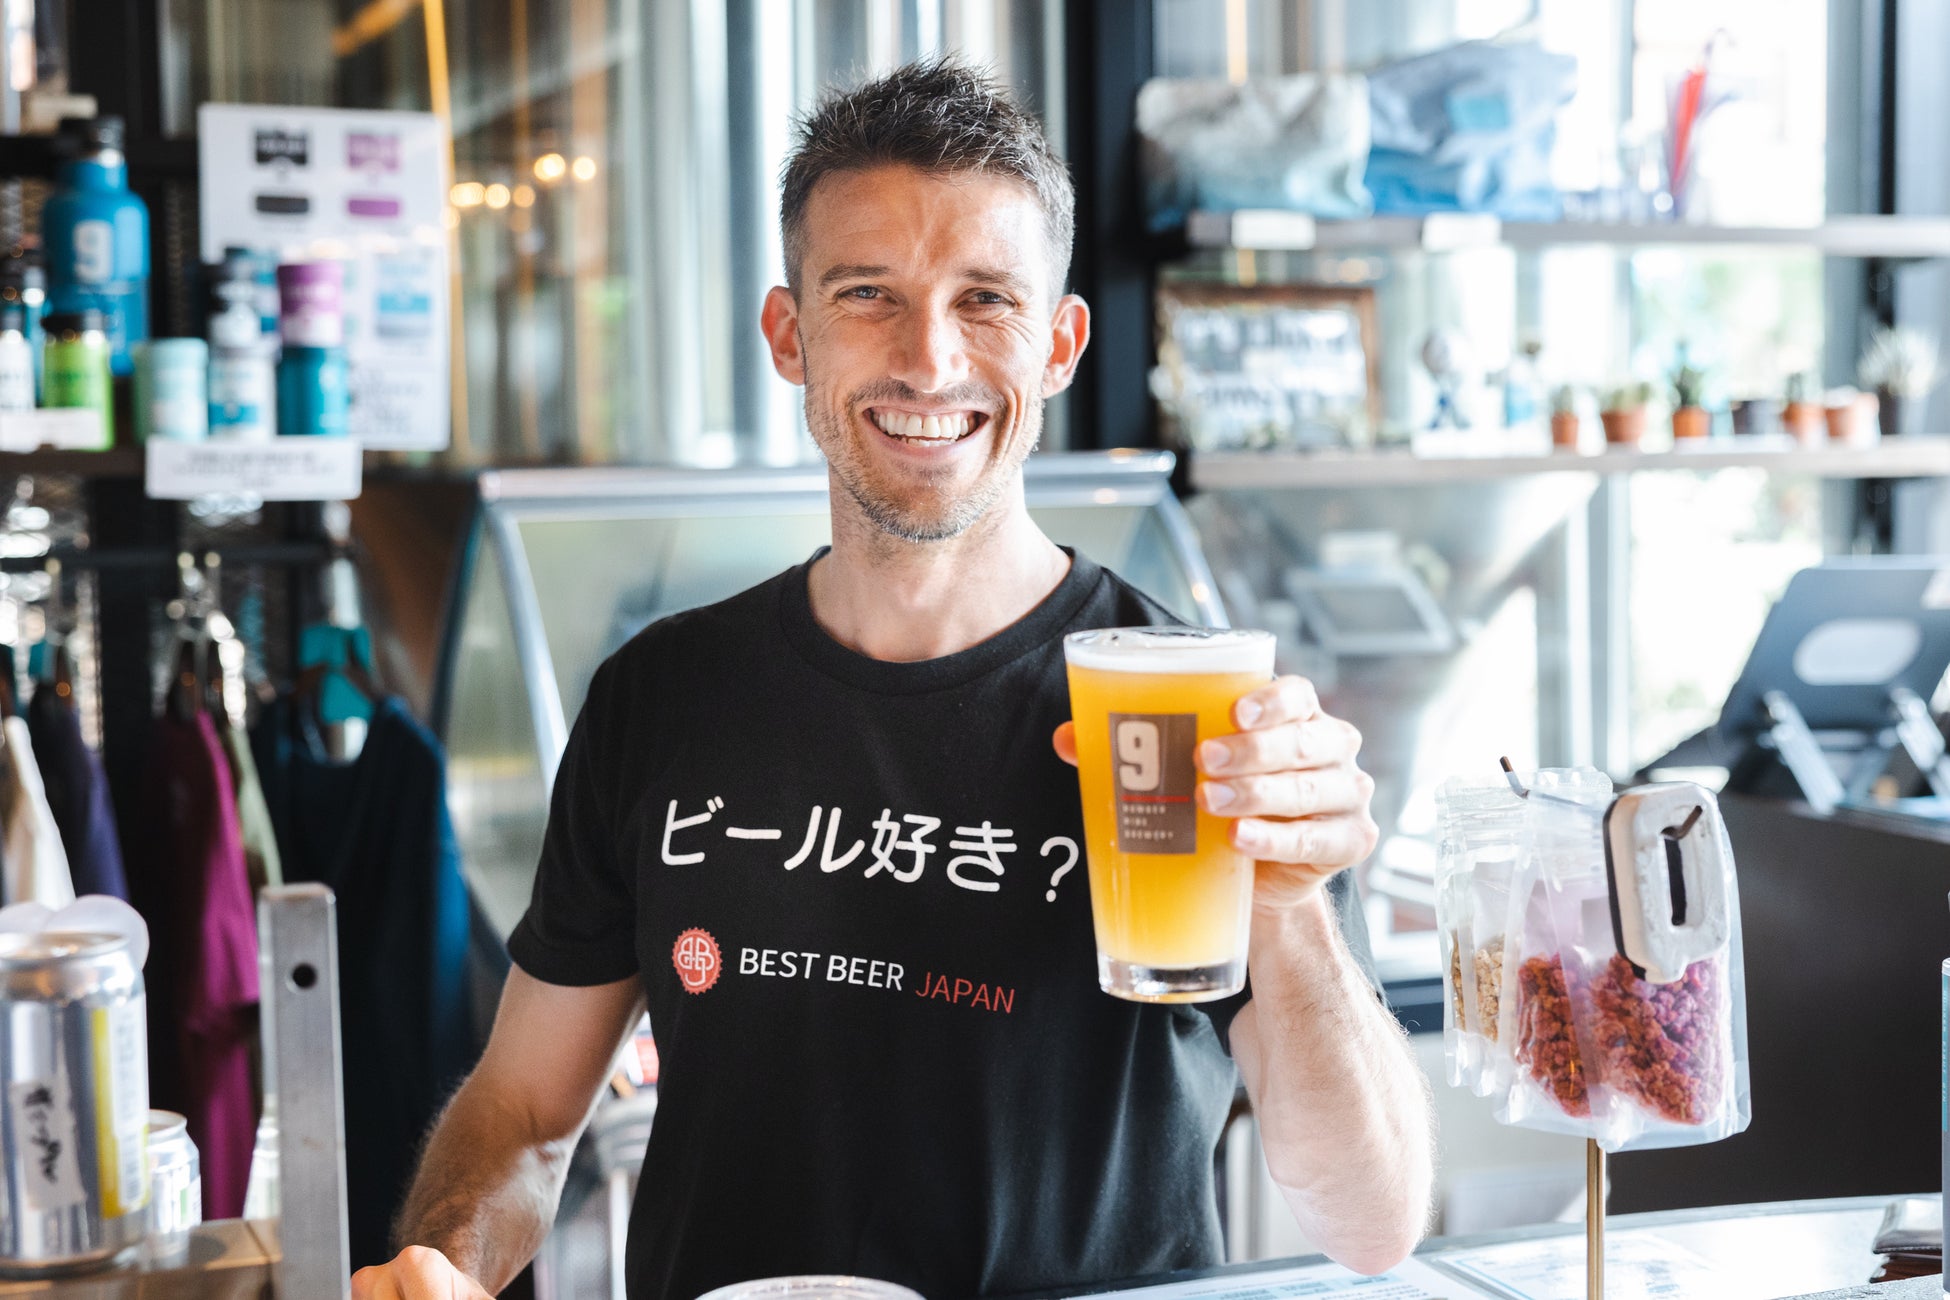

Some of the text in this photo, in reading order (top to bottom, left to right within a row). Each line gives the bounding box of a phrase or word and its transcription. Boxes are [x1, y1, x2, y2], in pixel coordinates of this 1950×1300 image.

[1117, 720, 1160, 792] 9
[661, 795, 1079, 903] ビール好き？
[739, 947, 1016, 1014] BEST BEER JAPAN
